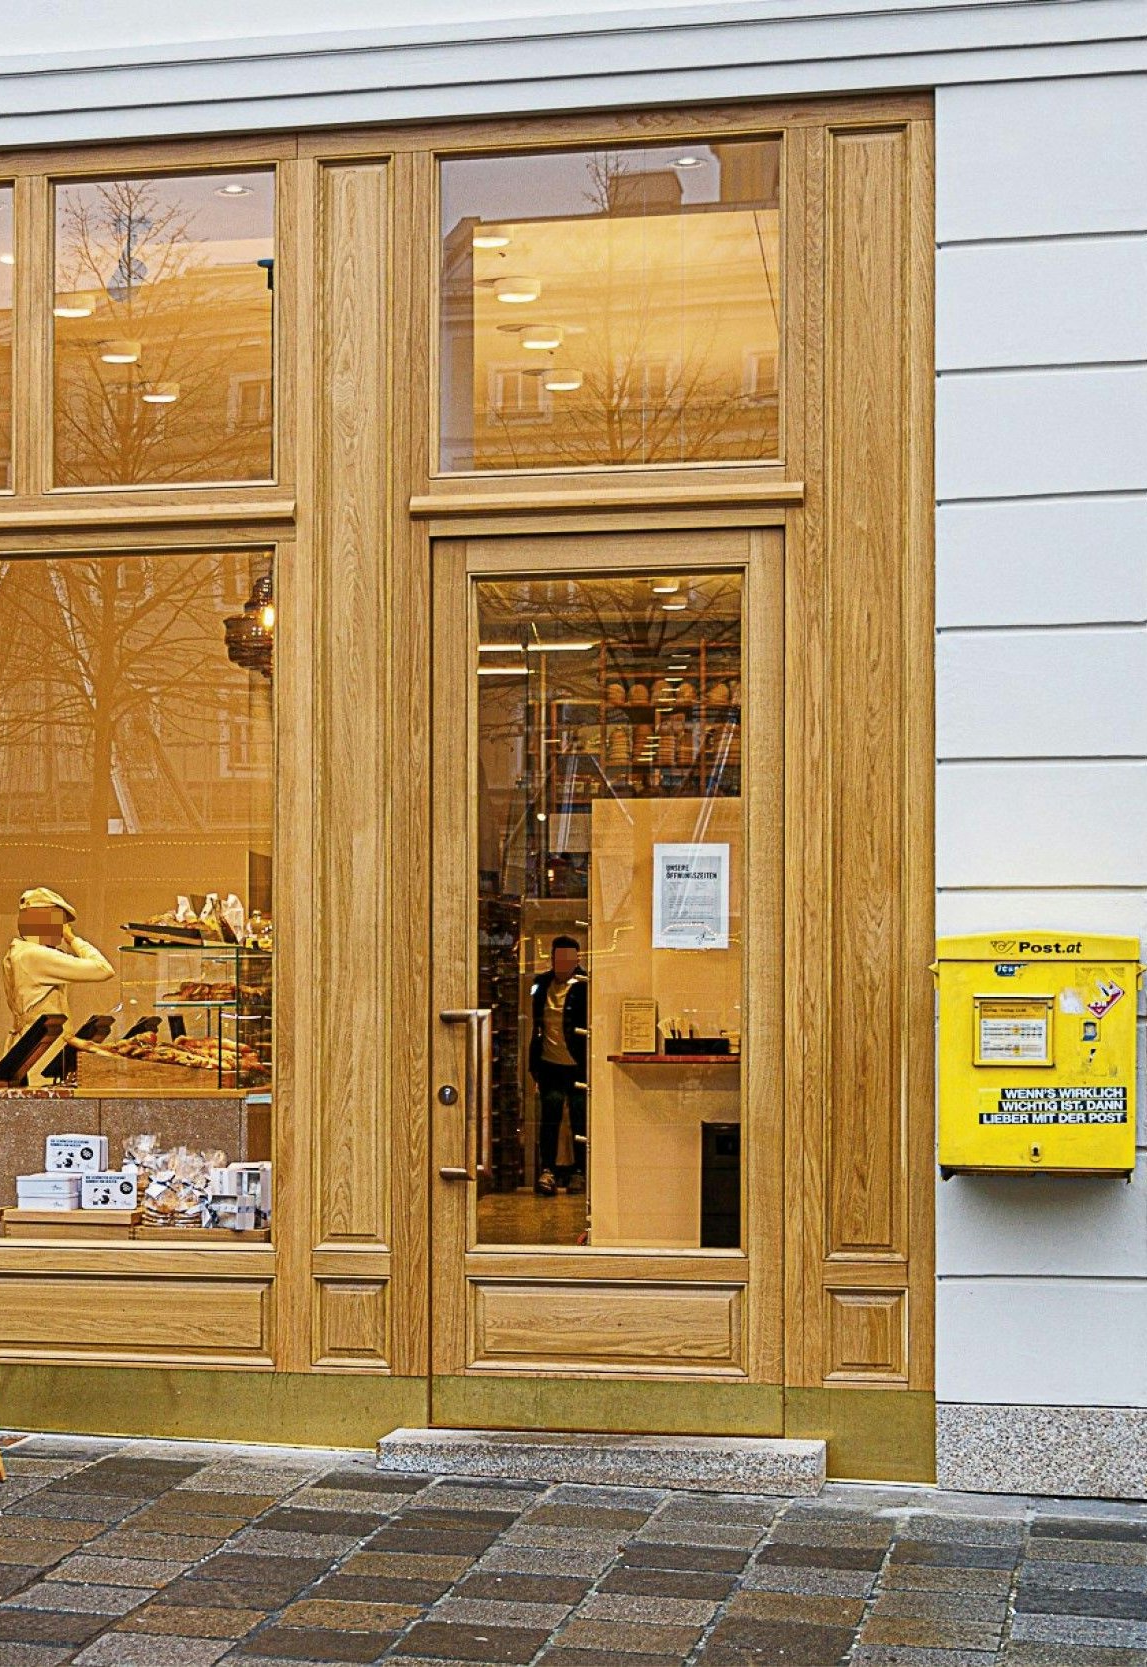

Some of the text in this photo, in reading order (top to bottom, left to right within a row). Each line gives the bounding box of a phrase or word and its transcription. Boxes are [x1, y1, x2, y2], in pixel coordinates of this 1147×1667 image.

[1019, 941, 1082, 954] Post.at
[1059, 1088, 1124, 1098] WIRKLICH
[1001, 1101, 1057, 1111] WICHTIG
[1086, 1100, 1124, 1110] DANN
[982, 1112, 1124, 1124] LIEBER MIT DER POST
